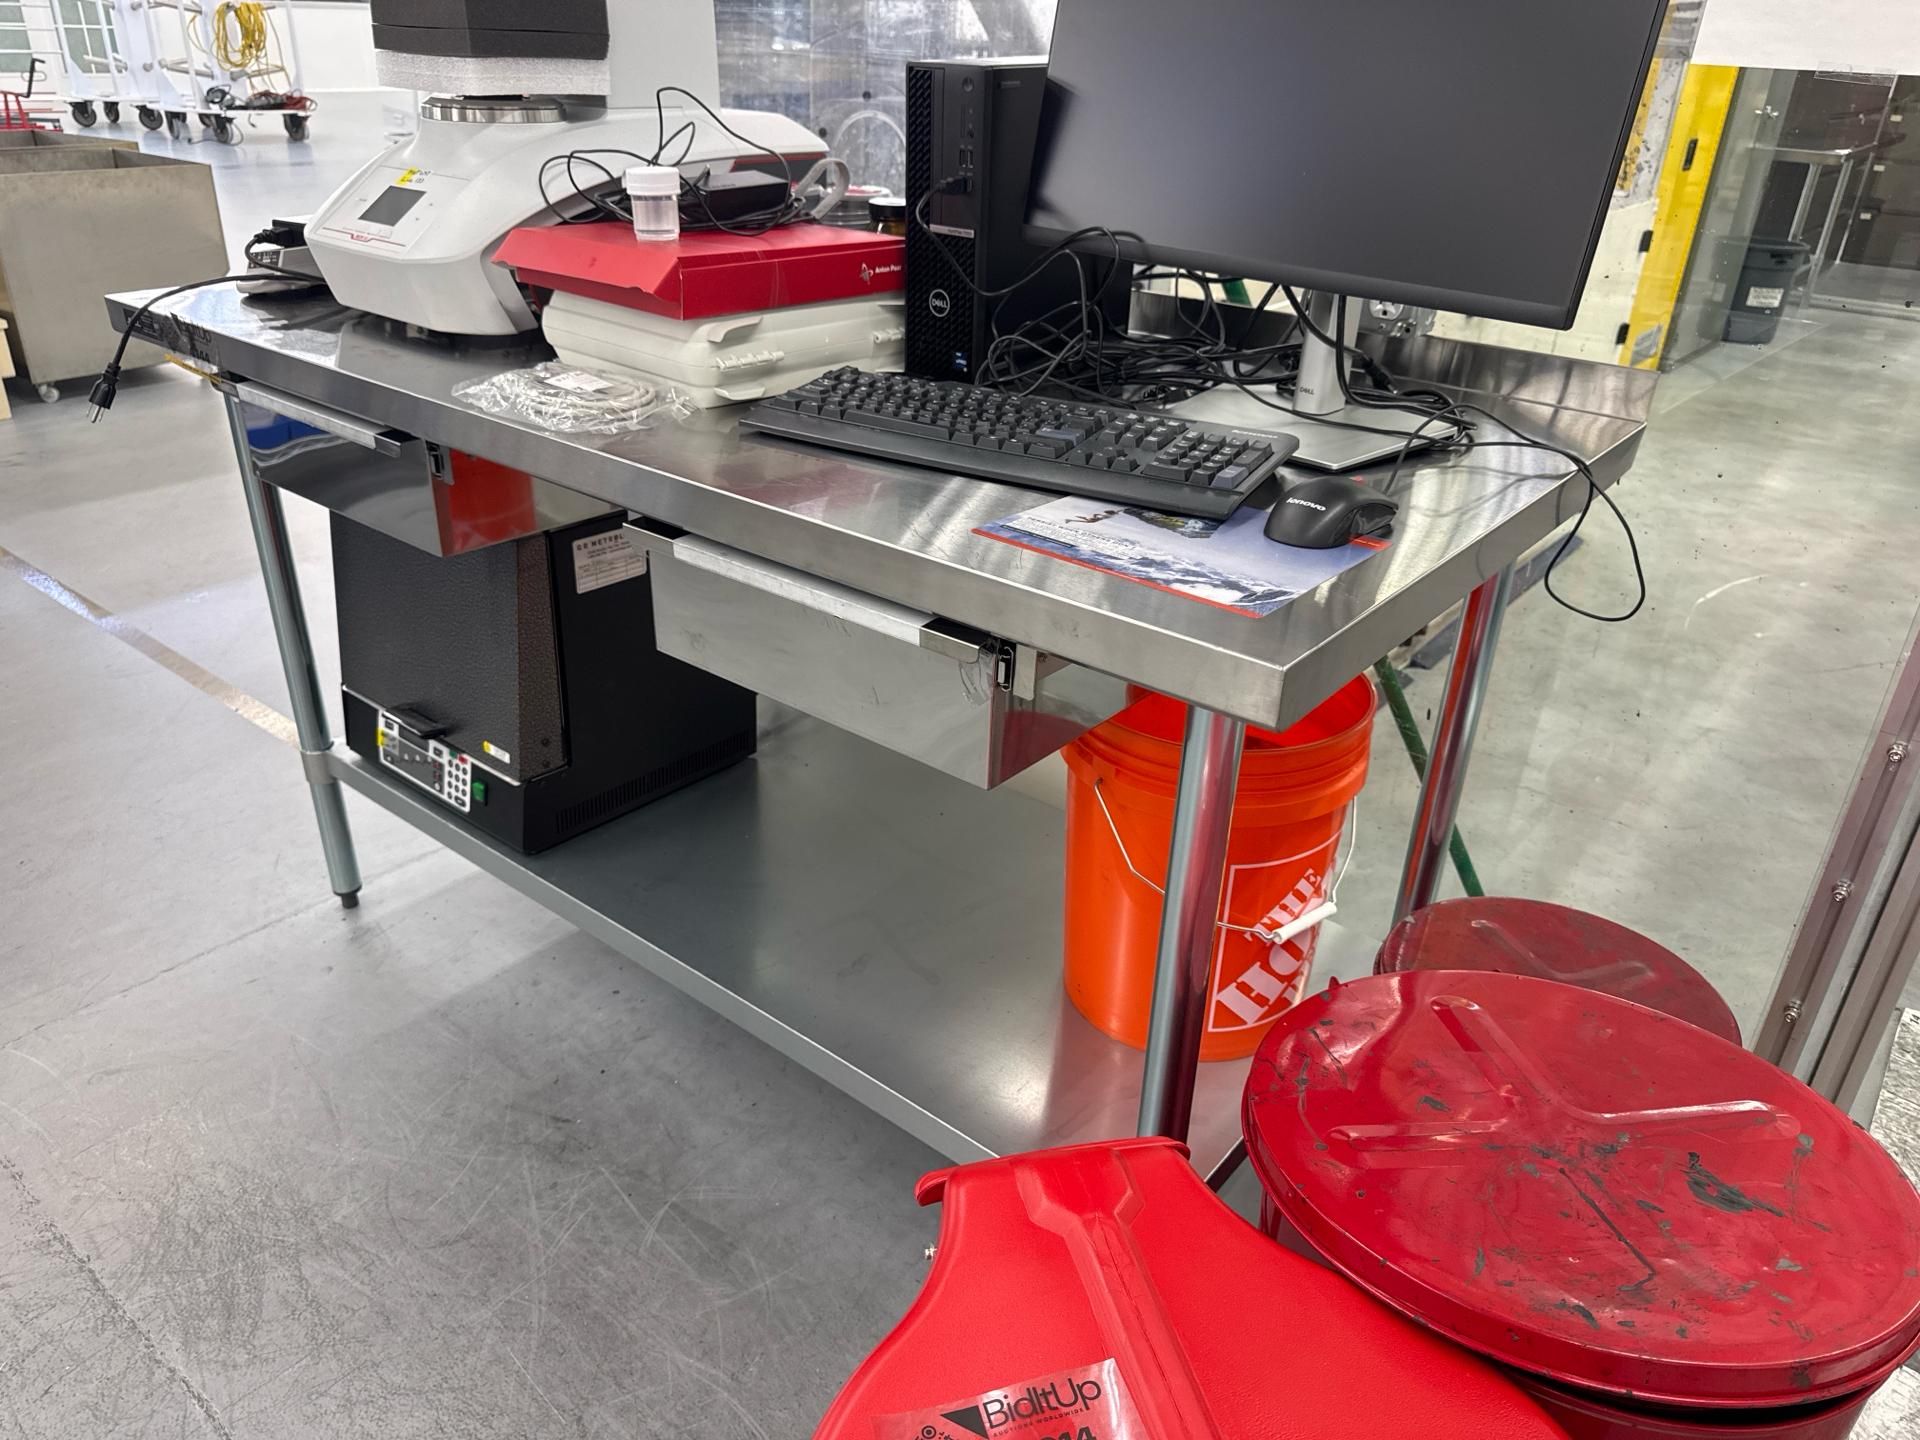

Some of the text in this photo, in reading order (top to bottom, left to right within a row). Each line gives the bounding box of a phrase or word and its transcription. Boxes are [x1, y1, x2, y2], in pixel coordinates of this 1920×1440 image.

[932, 298, 948, 309] DELL
[1299, 386, 1315, 396] DELL
[1285, 497, 1327, 511] lenovo
[1243, 868, 1321, 947] THE
[983, 1378, 1102, 1429] BidItUp
[1036, 1408, 1085, 1424] WORLDWIDE
